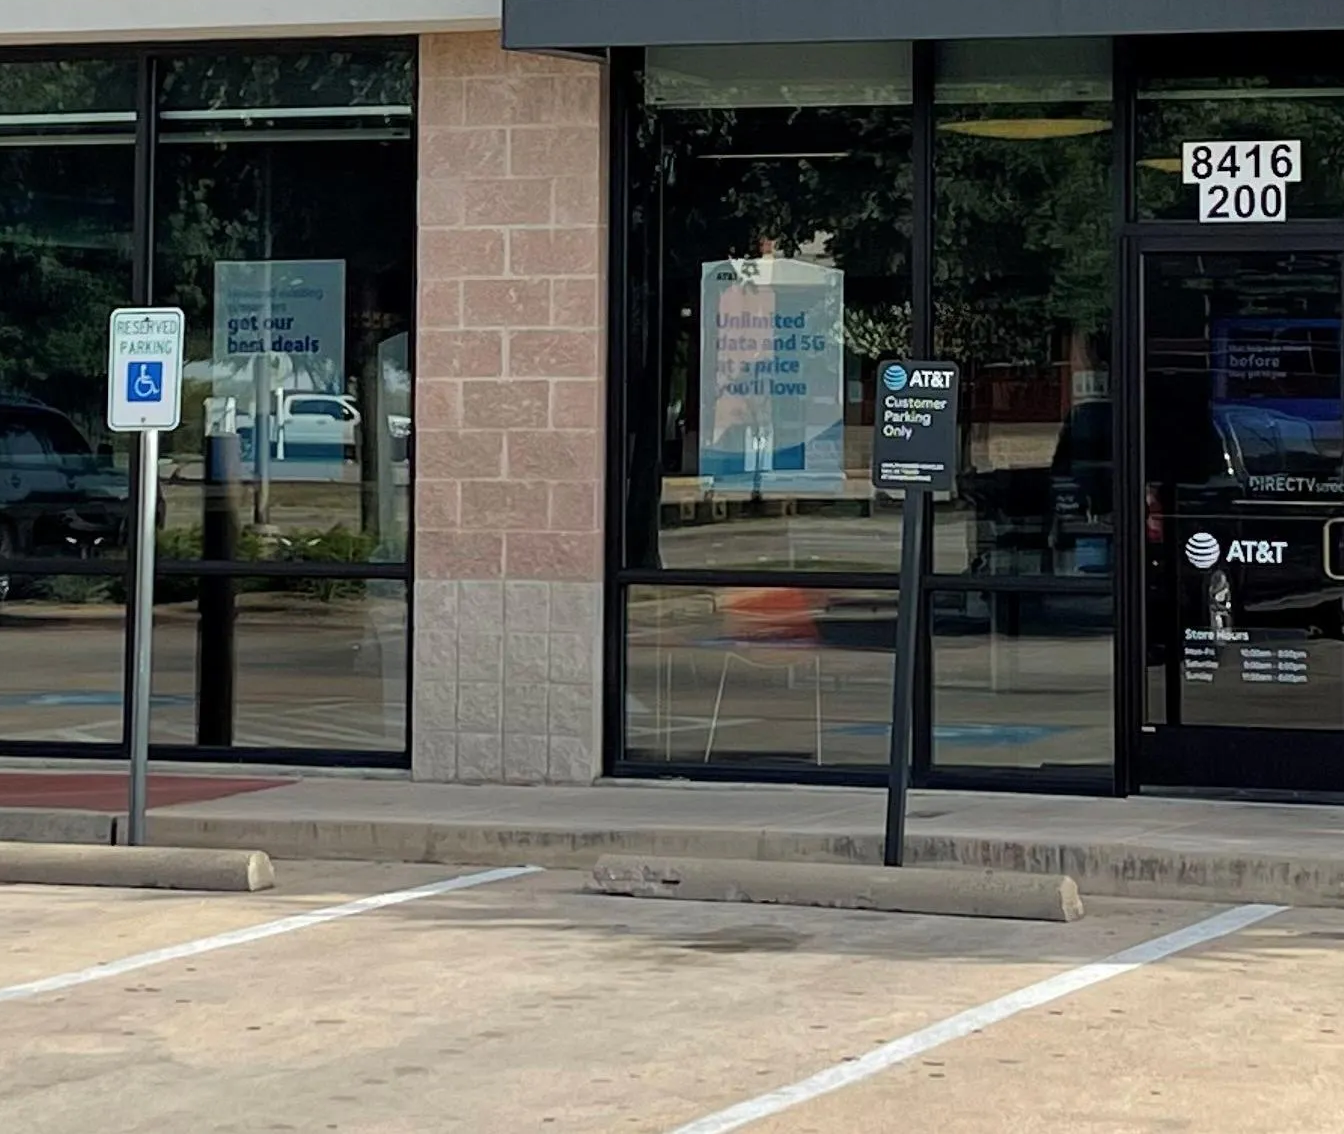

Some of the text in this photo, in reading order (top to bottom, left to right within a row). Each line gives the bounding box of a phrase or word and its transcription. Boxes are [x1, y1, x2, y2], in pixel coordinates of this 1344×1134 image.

[1191, 143, 1293, 179] 8416
[1206, 183, 1282, 219] 200
[117, 320, 178, 334] RESERVED
[227, 316, 294, 335] get our
[716, 311, 806, 329] Unlimited
[119, 339, 173, 355] PARKING
[227, 335, 320, 354] best deals
[716, 333, 825, 351] data and 5G
[756, 357, 800, 377] price
[769, 379, 807, 396] love
[909, 369, 954, 388] AT&T
[884, 395, 948, 410] Customer
[883, 410, 932, 427] Parking
[882, 424, 913, 440] Only
[1249, 475, 1315, 492] DIRECTV
[1225, 539, 1288, 564] AT&T
[1185, 628, 1250, 641] Store Hours
